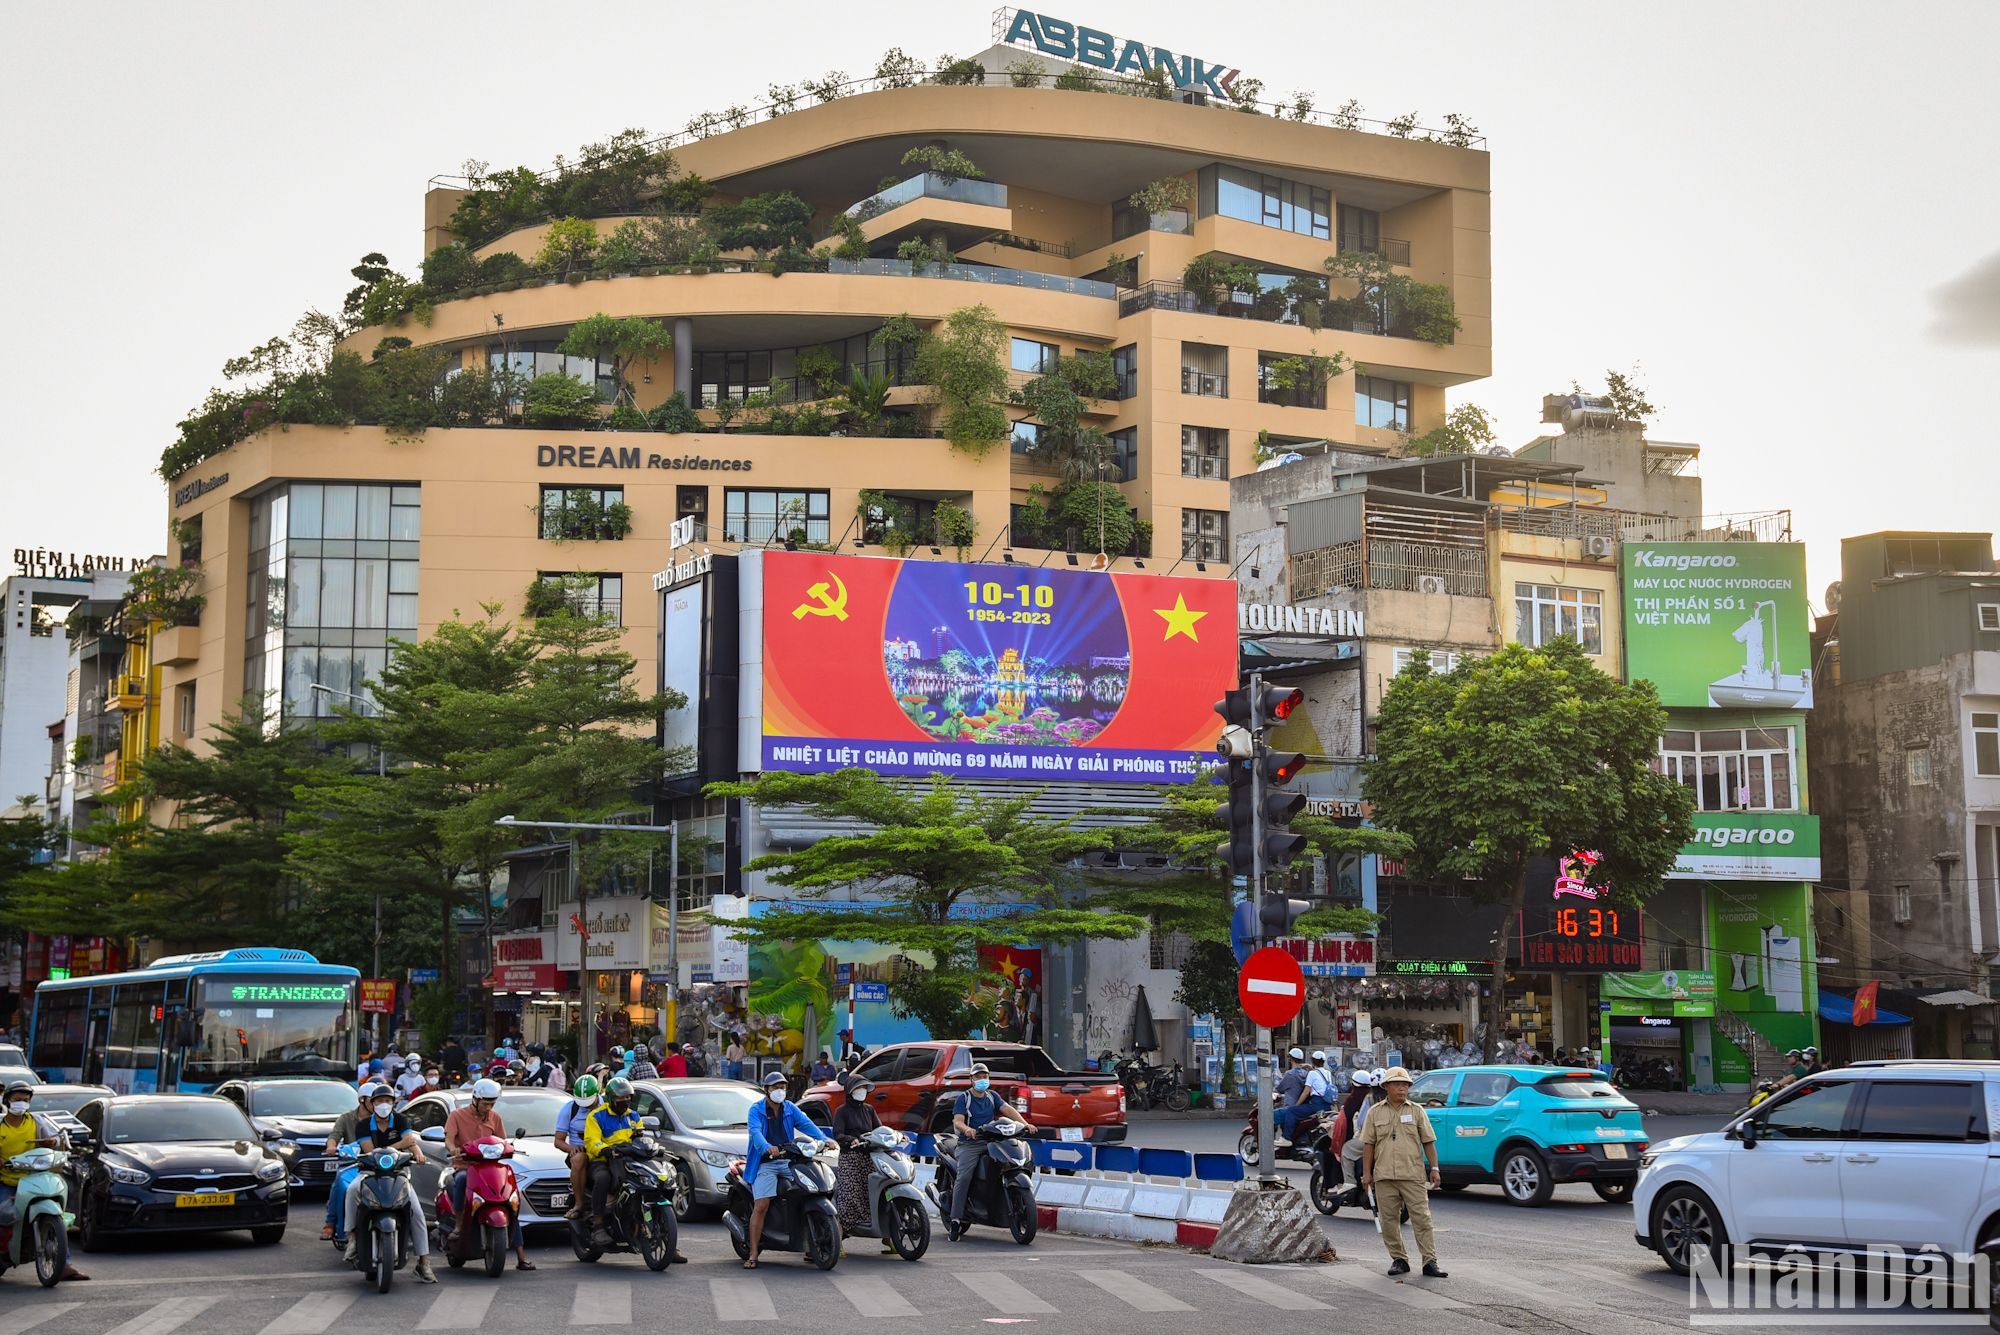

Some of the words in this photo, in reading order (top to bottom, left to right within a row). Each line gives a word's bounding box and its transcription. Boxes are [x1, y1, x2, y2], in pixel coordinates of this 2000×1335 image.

[1004, 9, 1229, 101] ABBANK
[537, 445, 640, 469] DREAM
[647, 454, 753, 471] Residences
[670, 514, 695, 549] EU
[652, 557, 674, 591] THỔ
[675, 555, 695, 582] NHĨ
[696, 547, 713, 575] KỲ
[1634, 550, 1737, 571] Kangaroo
[1633, 576, 1660, 589] MÁY
[1663, 578, 1686, 590] LỌC
[1689, 577, 1722, 589] NƯỚC
[1725, 579, 1792, 590] HYDROGEN
[964, 581, 1054, 608] 10-10
[1634, 597, 1660, 613] THỊ
[1713, 595, 1735, 610] SỐ
[1737, 599, 1746, 610] 1
[967, 609, 1051, 625] 1954-2023
[1634, 611, 1669, 626] VIỆT
[1673, 613, 1711, 625] NAM
[773, 745, 822, 765] NHIỆT
[827, 746, 860, 766] LIỆT
[865, 748, 909, 766] CHÀO
[913, 750, 962, 767] MỪNG
[966, 753, 986, 768] 69
[990, 752, 1027, 769] NĂM
[1032, 754, 1074, 770] NGÀY
[1078, 753, 1109, 772] GIẢI
[1113, 755, 1165, 773] PHÓNG
[1168, 752, 1197, 774] THỦ
[1306, 800, 1333, 816] UICE
[1339, 802, 1364, 817] TEA
[1693, 827, 1795, 848] ngaroo
[1566, 881, 1583, 892] Since
[1557, 908, 1579, 937] 16
[1588, 908, 1618, 937] 37
[1719, 913, 1758, 922] HYDROGEN
[496, 937, 543, 962] TOSHIBA
[1344, 941, 1373, 963] SƠN
[1397, 962, 1419, 973] QUẠT
[1421, 961, 1441, 974] ĐIỆN
[1441, 963, 1447, 972] 4
[1448, 961, 1467, 973] MÙA
[248, 986, 346, 1000] TRANSERCO
[365, 991, 373, 999] XE
[375, 991, 389, 999] MÁY
[1640, 1016, 1671, 1026] Kangaroo
[182, 1195, 231, 1205] 17A-233.05
